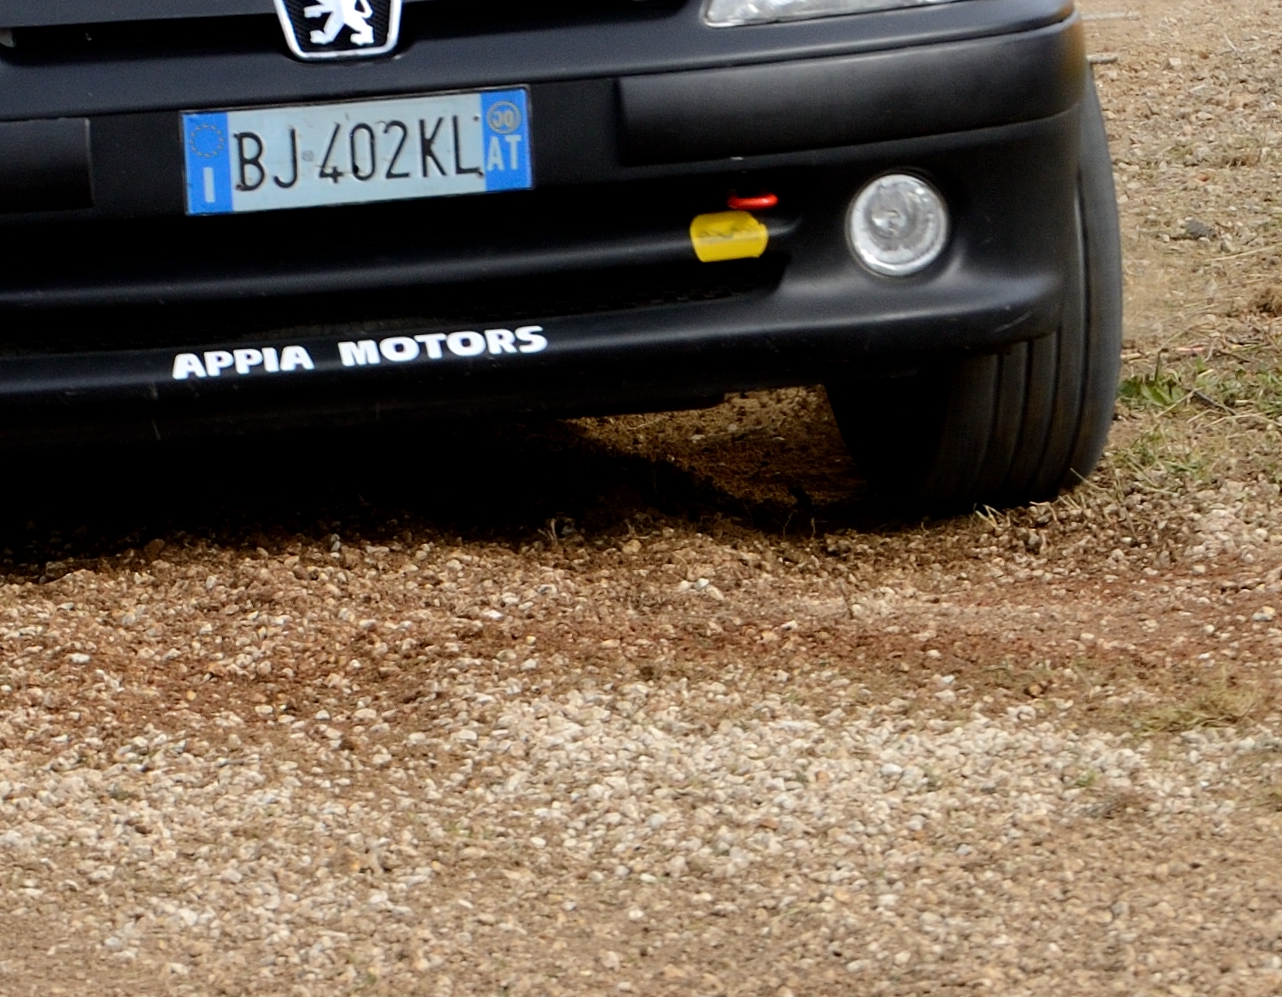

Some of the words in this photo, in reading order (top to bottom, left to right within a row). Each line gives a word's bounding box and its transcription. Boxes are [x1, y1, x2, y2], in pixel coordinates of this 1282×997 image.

[229, 126, 299, 193] BJ
[317, 114, 487, 185] 402KL
[486, 134, 523, 171] AT
[171, 345, 316, 380] APPIA
[337, 325, 548, 367] MOTORS
